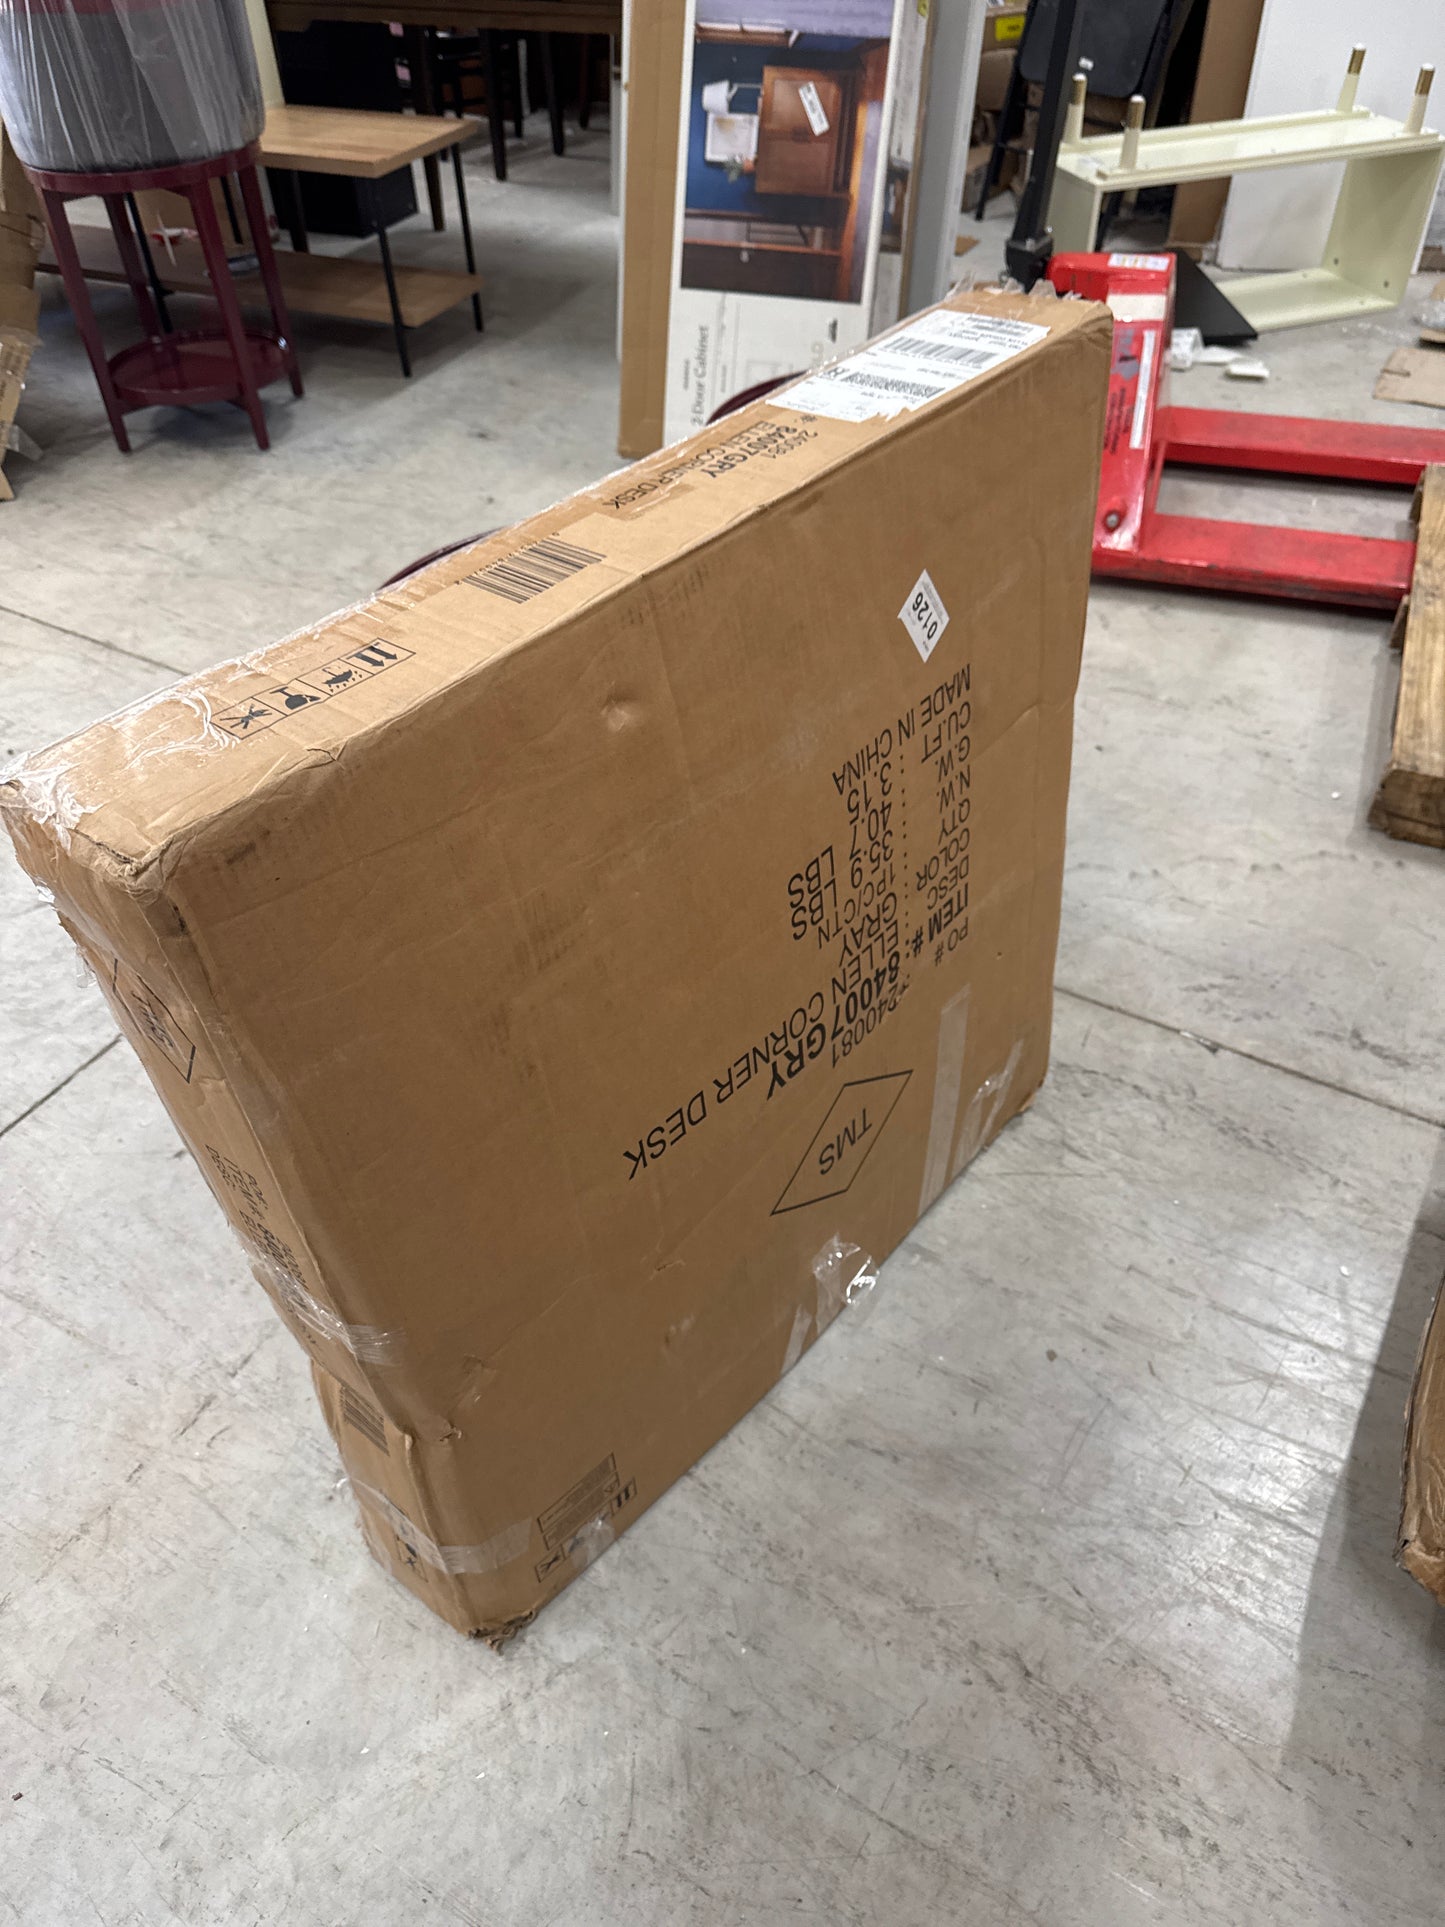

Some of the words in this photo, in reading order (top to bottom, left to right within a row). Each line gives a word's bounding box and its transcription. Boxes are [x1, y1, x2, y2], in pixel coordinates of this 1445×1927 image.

[694, 325, 709, 378] Cabinet
[691, 381, 706, 414] Door
[656, 444, 726, 485] CORNER
[699, 425, 797, 480] 84007GRY
[602, 479, 658, 511] DESK
[912, 592, 938, 640] 0126
[919, 664, 970, 726] MADE
[897, 708, 915, 745] IN
[919, 700, 971, 763] CU.FT
[831, 728, 892, 794] CHINA
[934, 734, 970, 782] G.W.
[846, 762, 892, 825] 3.15
[936, 766, 970, 813] N.W.
[848, 800, 892, 858] 40.7
[937, 798, 970, 845] QTY
[786, 846, 834, 909] LBS
[849, 829, 893, 889] 35.9
[915, 828, 970, 891] COLOR
[926, 855, 969, 909] DESC
[791, 879, 837, 941] LBS
[817, 862, 896, 948] 1PC/CTN
[838, 891, 897, 966] GRAY
[928, 883, 968, 932] ITEM
[948, 917, 968, 943] PO
[831, 919, 898, 1003] ELLEN
[712, 991, 823, 1103] CORNER
[831, 983, 898, 1068] 240081
[622, 1091, 706, 1180] DESK
[818, 1107, 872, 1176] TMS
